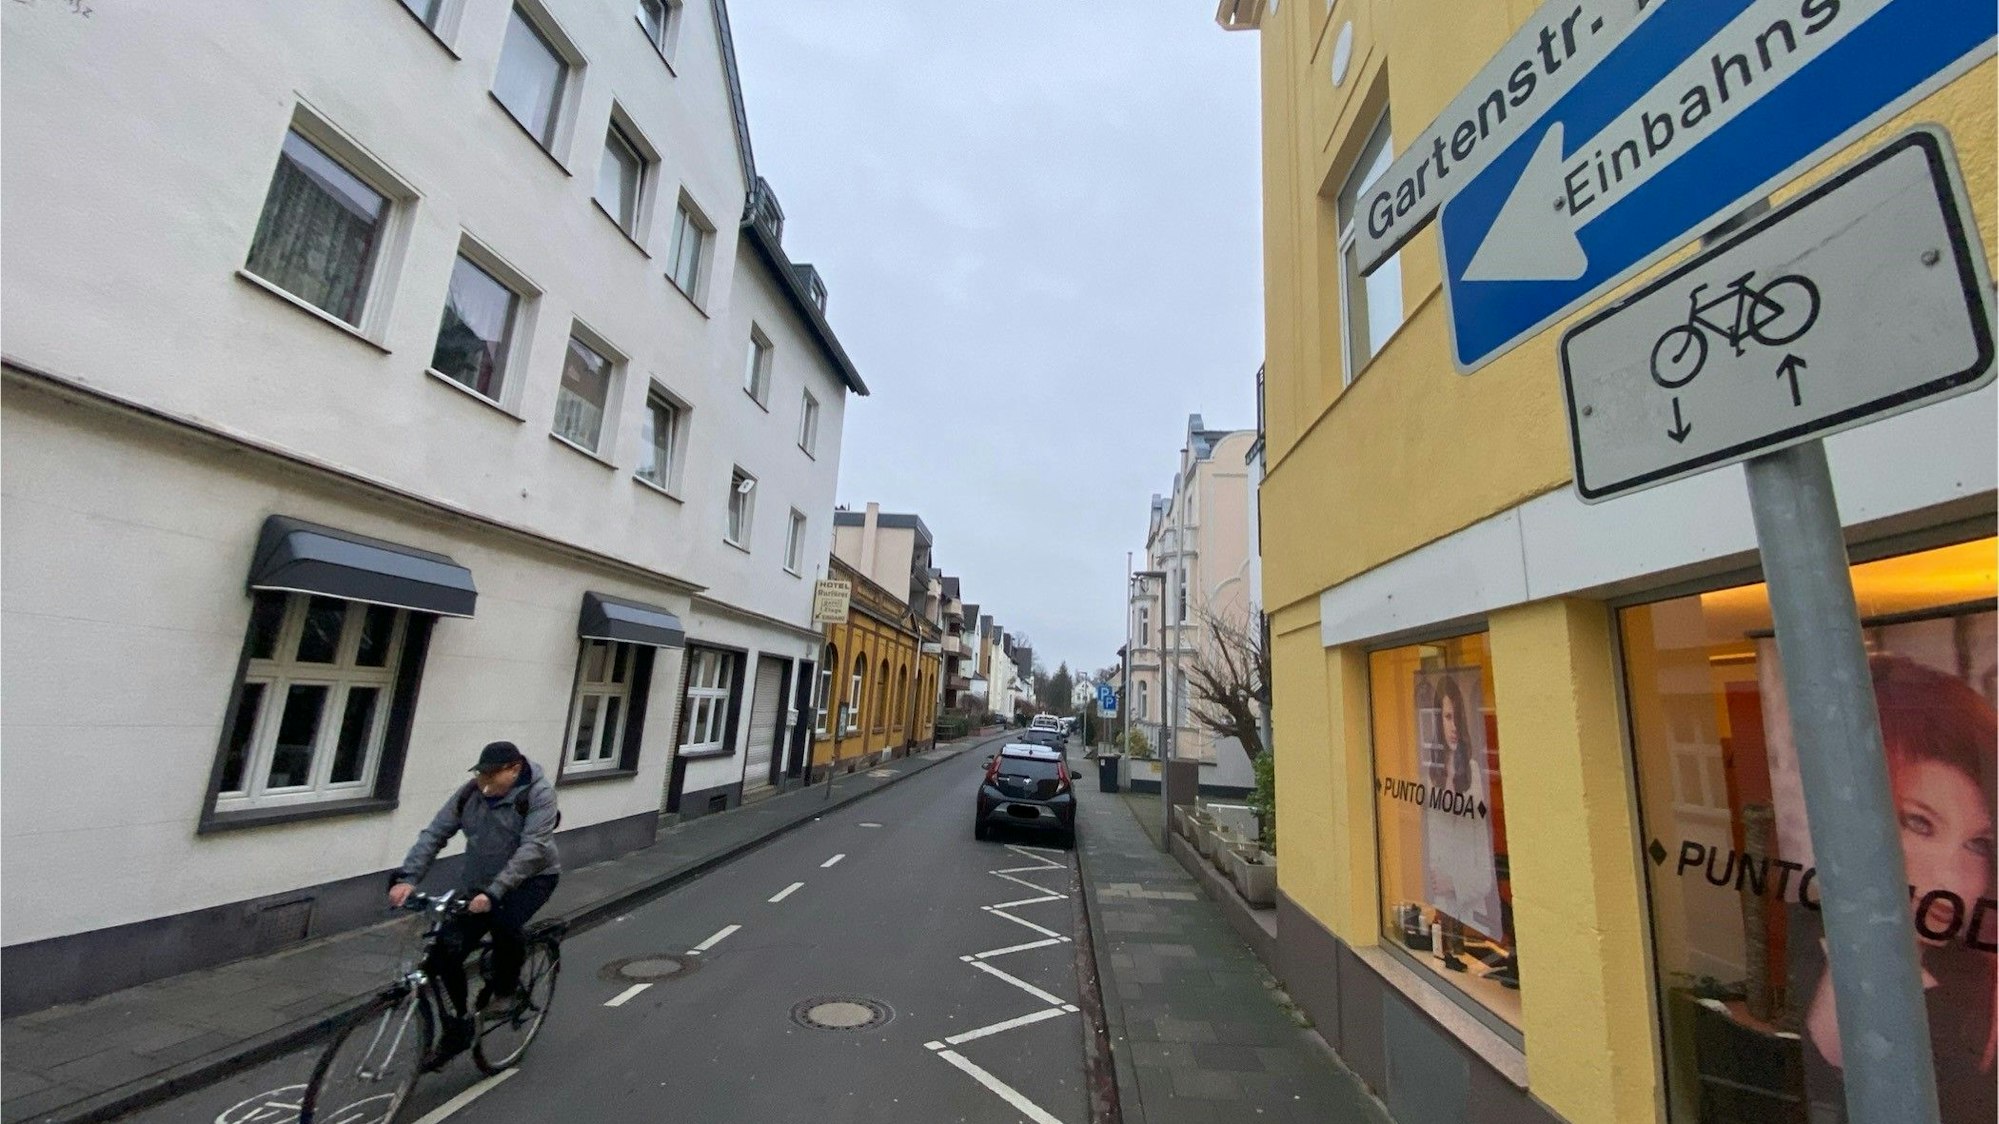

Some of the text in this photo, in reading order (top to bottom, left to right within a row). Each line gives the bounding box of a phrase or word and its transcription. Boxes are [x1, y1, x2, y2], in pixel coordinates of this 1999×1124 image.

[1368, 4, 1603, 240] Gartenstr.
[1564, 0, 1841, 217] Einbahns
[1101, 687, 1110, 701] P
[1106, 697, 1114, 708] P
[1384, 777, 1475, 819] PUNTO MODA
